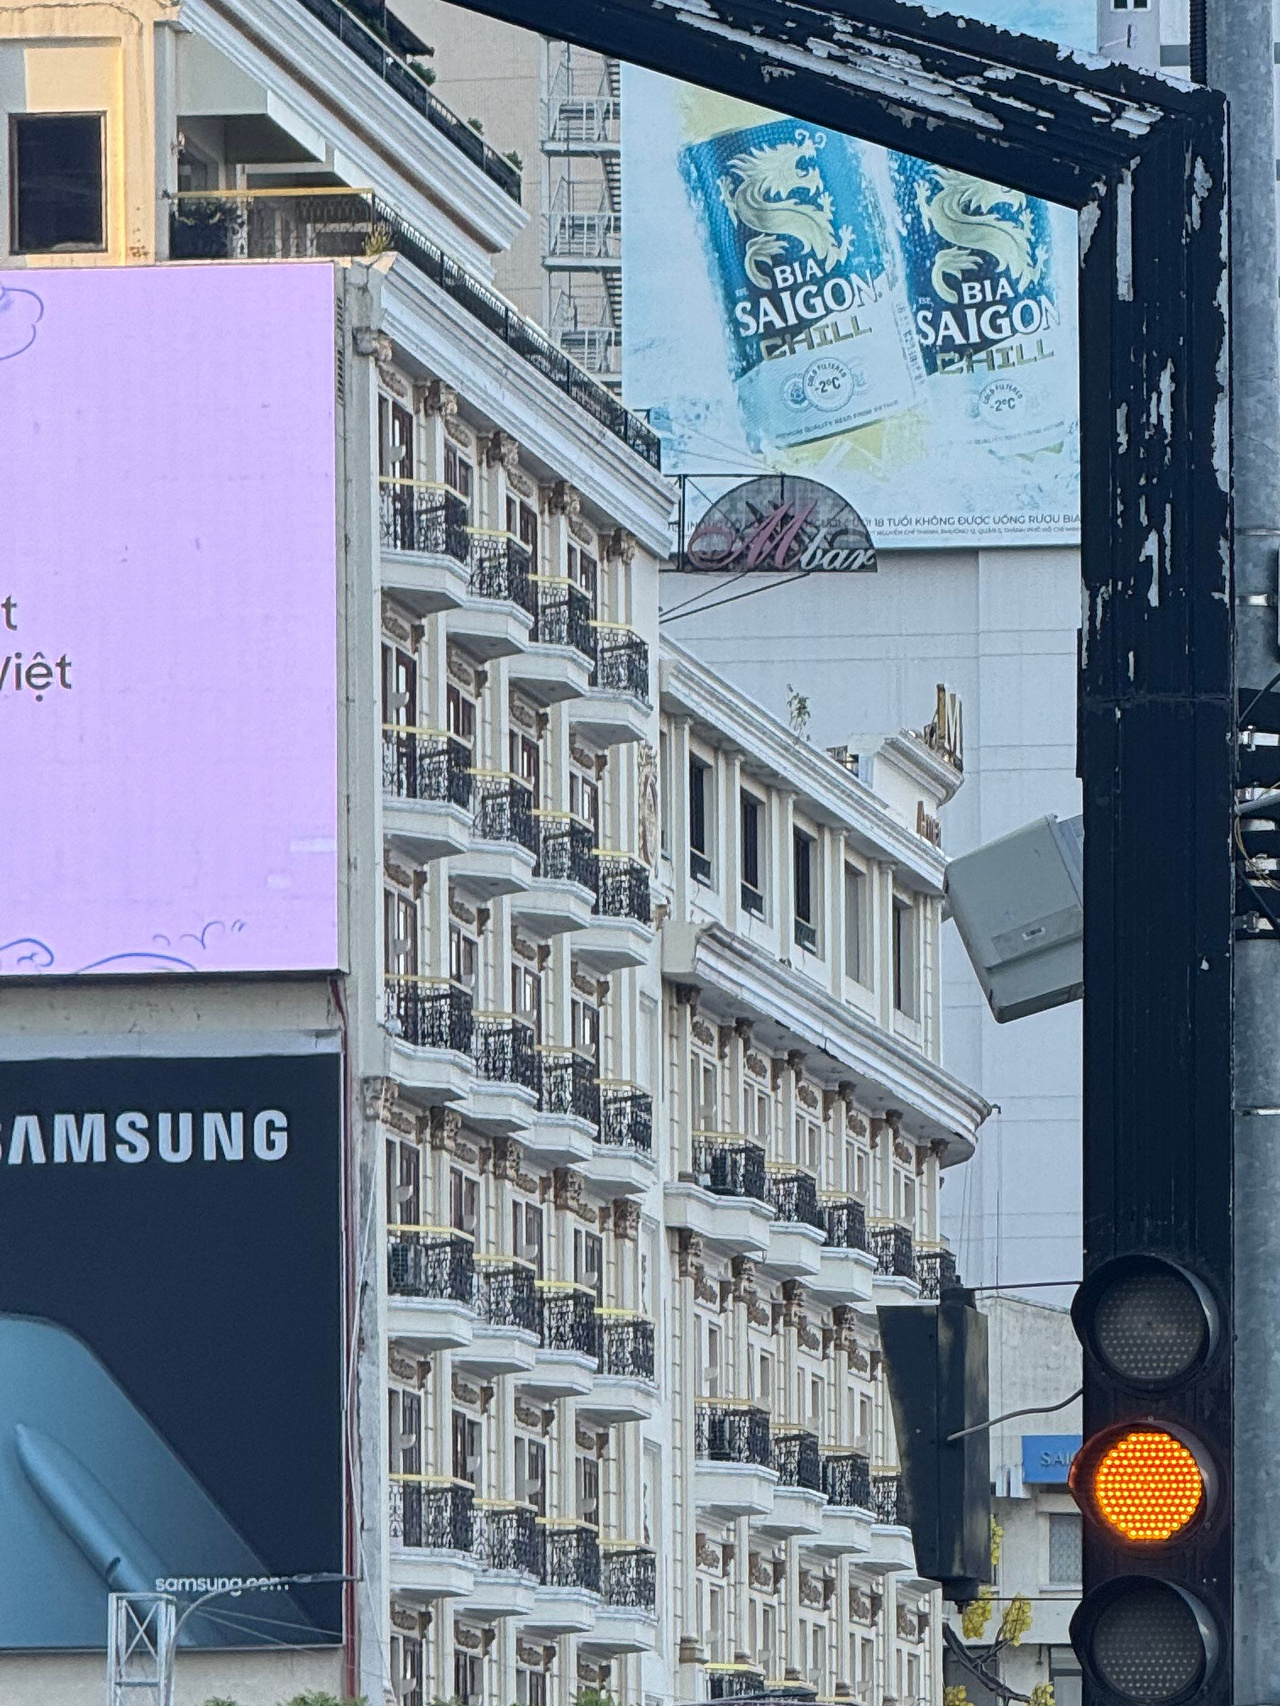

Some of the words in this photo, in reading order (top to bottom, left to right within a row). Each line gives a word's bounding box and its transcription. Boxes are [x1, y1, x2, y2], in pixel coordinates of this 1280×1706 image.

[773, 258, 823, 289] BIA
[735, 270, 878, 337] SAIGON
[961, 277, 1015, 305] BIA
[916, 290, 1061, 346] SAIGON
[761, 316, 872, 361] CHILL
[817, 362, 847, 378] FILTERED
[936, 339, 1054, 374] CHILL
[874, 518, 884, 527] 18
[915, 514, 955, 526] KHÔNG
[1063, 514, 1081, 523] BIA
[0, 1110, 288, 1164] AMSUNG
[1040, 1450, 1075, 1467] SAI
